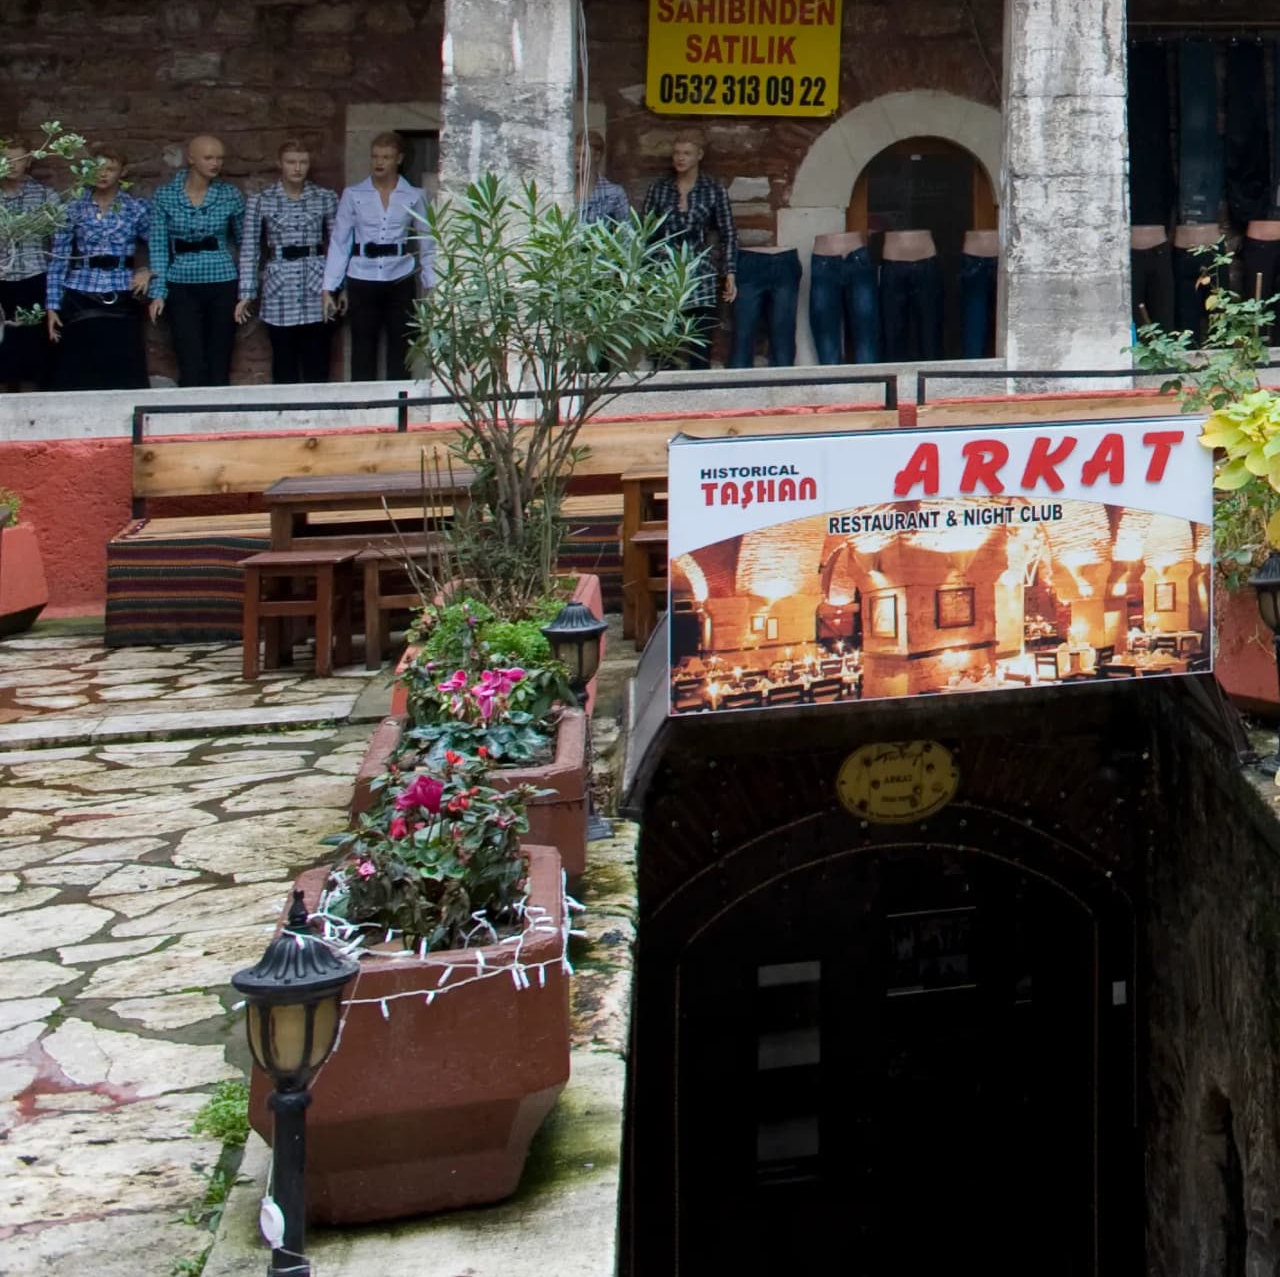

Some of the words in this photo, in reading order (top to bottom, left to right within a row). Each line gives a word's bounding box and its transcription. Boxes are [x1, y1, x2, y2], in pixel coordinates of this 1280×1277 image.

[685, 33, 797, 65] SATILIK
[659, 73, 717, 105] 0532
[721, 75, 761, 106] 313
[765, 75, 795, 106] 09
[799, 77, 827, 106] 22
[700, 463, 800, 481] HISTORICAL
[894, 430, 1185, 498] ARKAT
[828, 509, 941, 535] RESTAURANT
[945, 509, 959, 528] &
[963, 505, 1016, 527] NIGHT
[1019, 503, 1064, 523] CLUB
